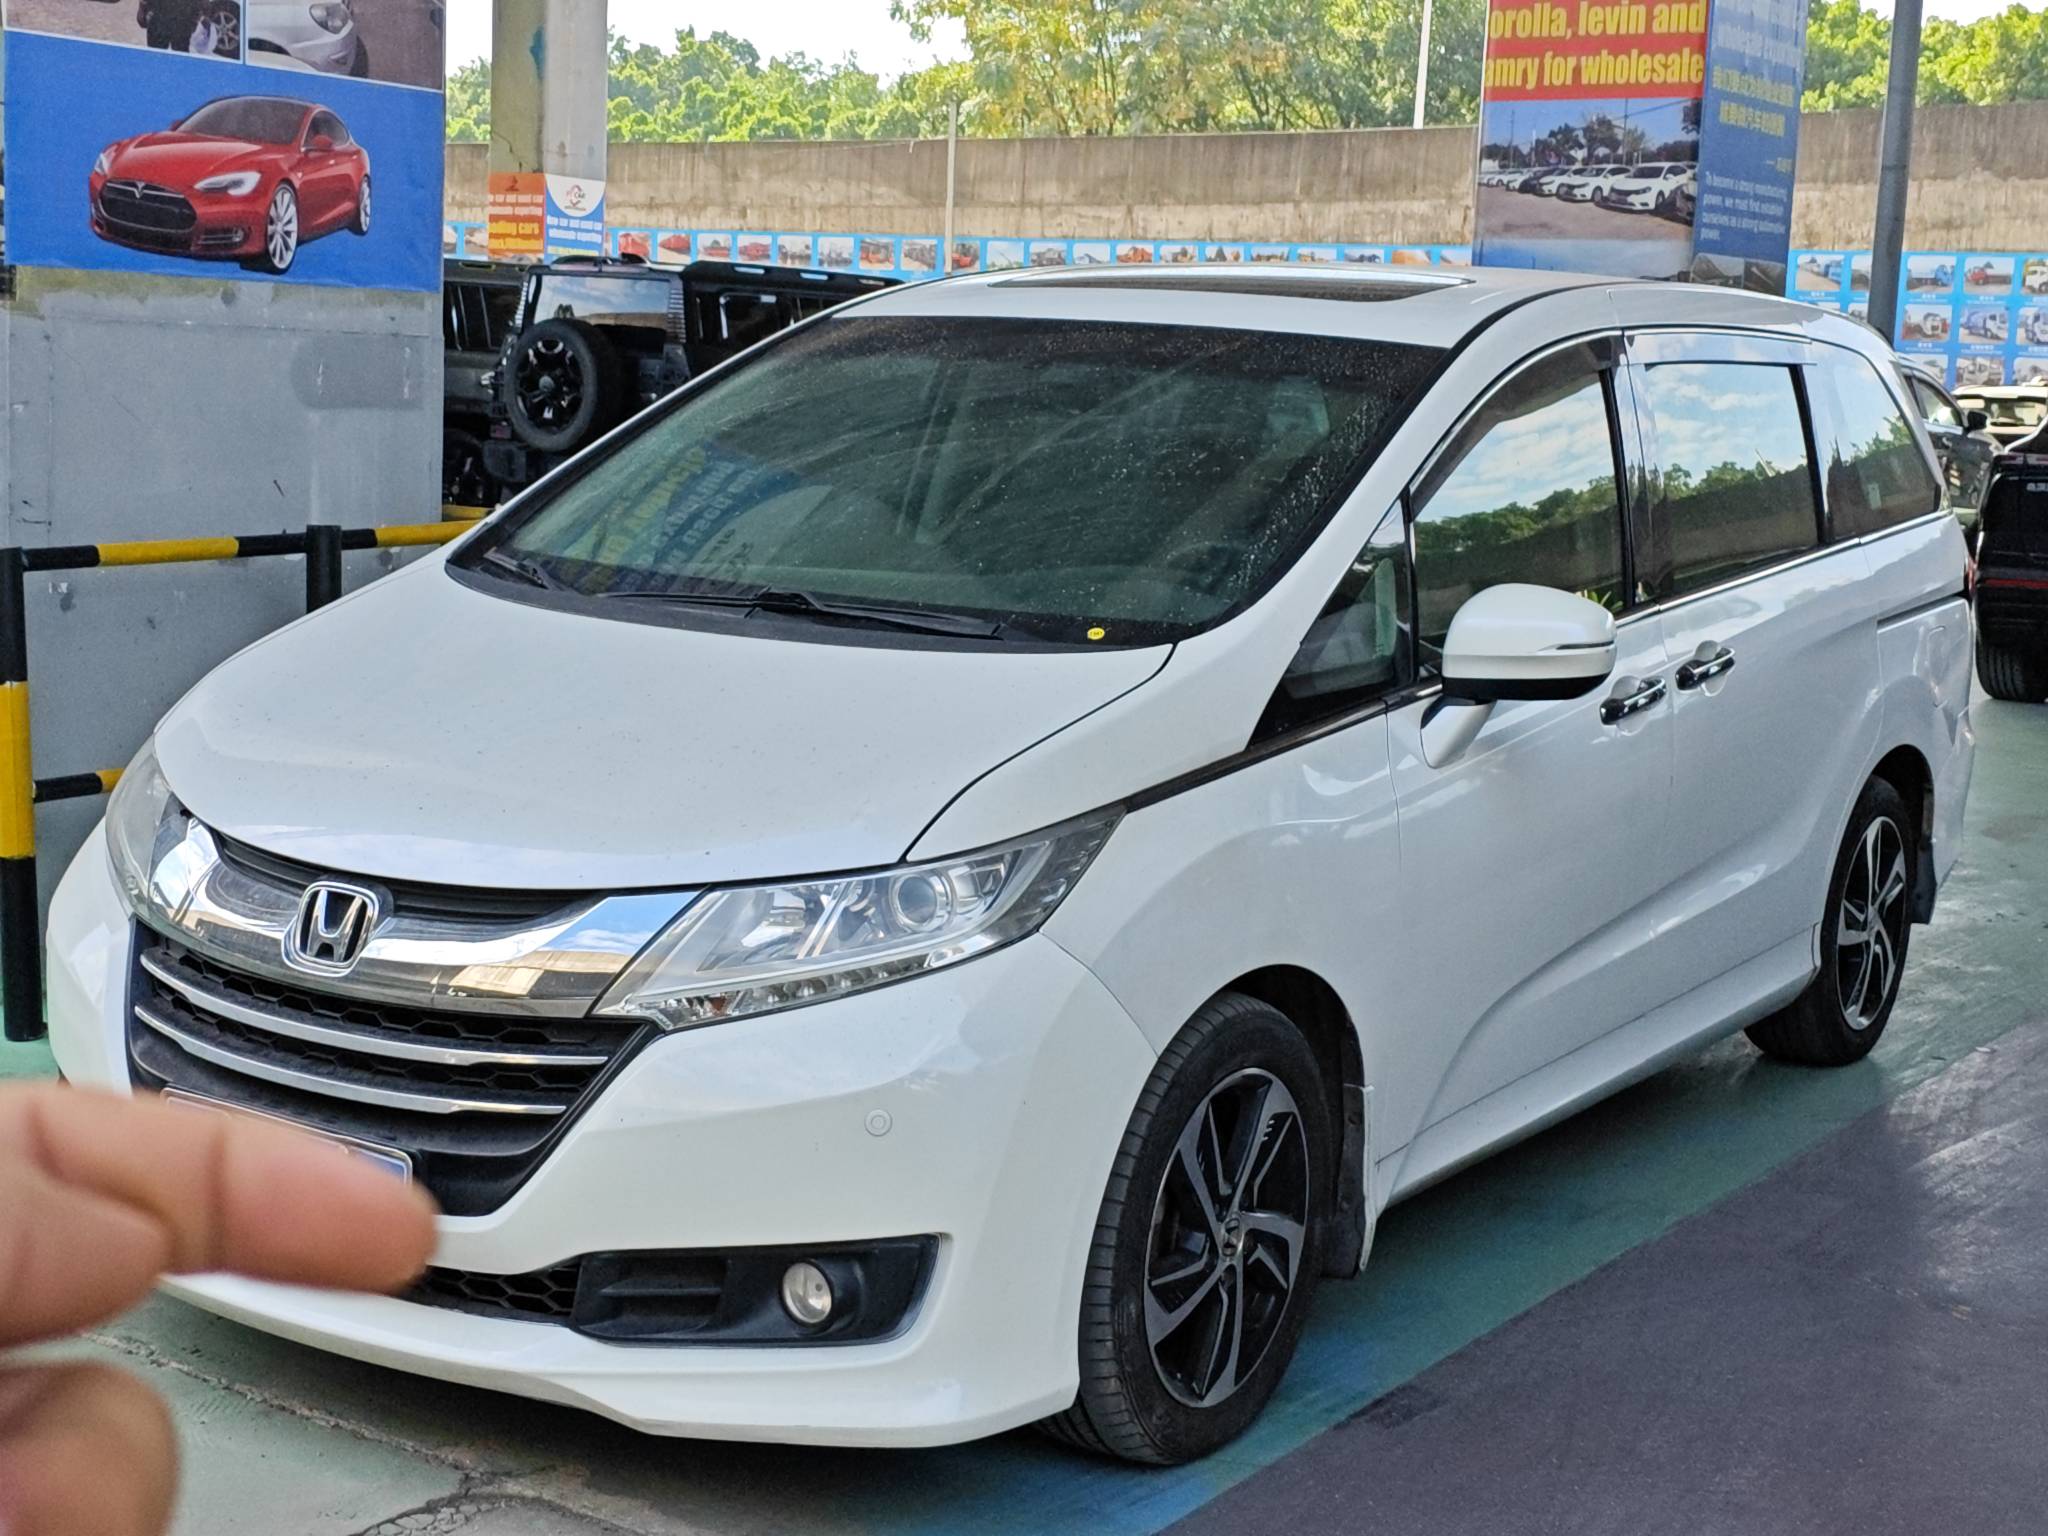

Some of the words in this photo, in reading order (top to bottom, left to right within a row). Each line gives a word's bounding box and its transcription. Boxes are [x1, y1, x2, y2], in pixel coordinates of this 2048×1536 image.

[1489, 3, 1572, 40] orolla,
[1577, 0, 1647, 37] levin
[1652, 1, 1706, 34] and
[1543, 50, 1578, 87] for
[1580, 47, 1704, 86] wholesale
